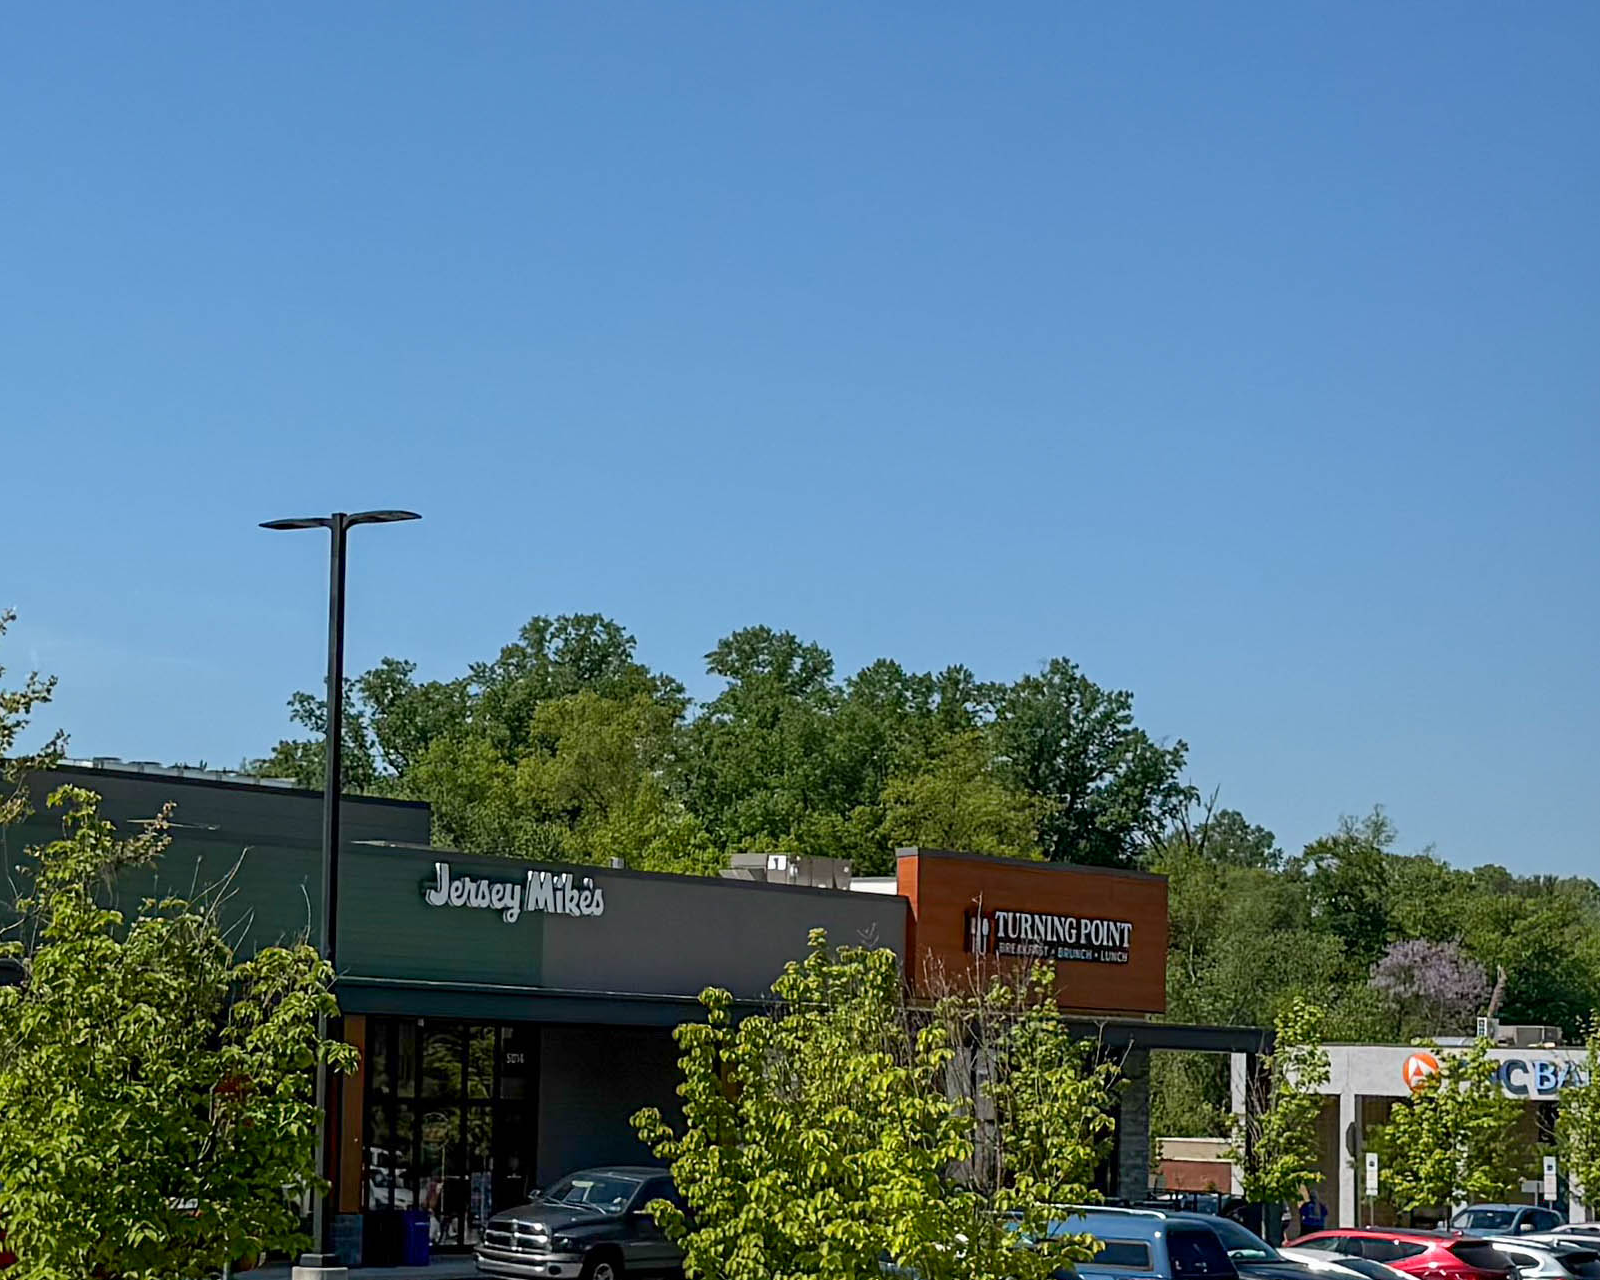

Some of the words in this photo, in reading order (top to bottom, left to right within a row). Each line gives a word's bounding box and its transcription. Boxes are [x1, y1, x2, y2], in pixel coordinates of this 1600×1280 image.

[425, 862, 522, 923] Jersey
[524, 870, 605, 917] Mike's
[995, 911, 1077, 944] TURNING
[1080, 919, 1133, 947] POINT
[999, 942, 1049, 958] BREAKFAST
[1057, 946, 1093, 960] BRUNCH
[1100, 950, 1128, 962] LUNCH
